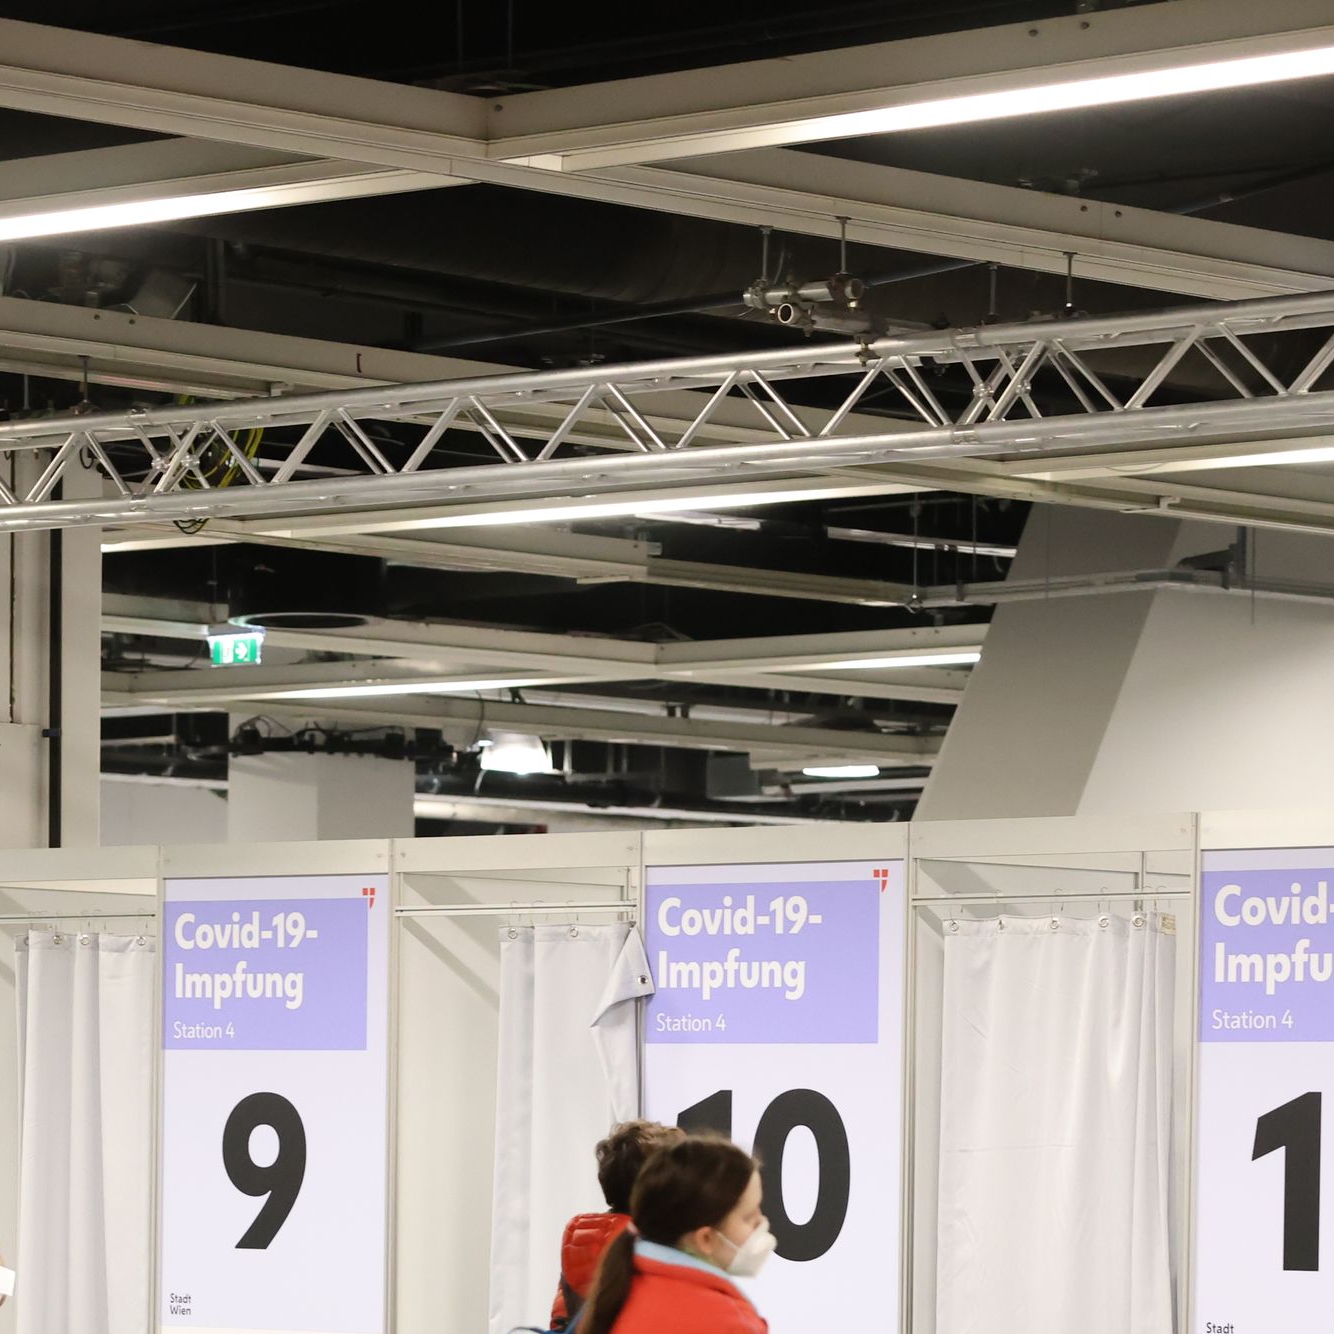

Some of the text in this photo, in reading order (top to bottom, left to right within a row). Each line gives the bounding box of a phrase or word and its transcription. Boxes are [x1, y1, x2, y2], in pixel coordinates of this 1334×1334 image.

[657, 894, 822, 937] Covid-19-
[174, 911, 319, 950] Covid-19-
[175, 960, 304, 1010] Impfung
[658, 947, 806, 1001] Impfung
[173, 1020, 235, 1039] Station 4
[656, 1012, 727, 1032] Station 4
[1211, 1008, 1294, 1030] Station 4
[222, 1091, 307, 1250] 9
[170, 1292, 192, 1304] Stadt
[169, 1304, 192, 1316] Wien
[1206, 1321, 1235, 1334] Stadt
